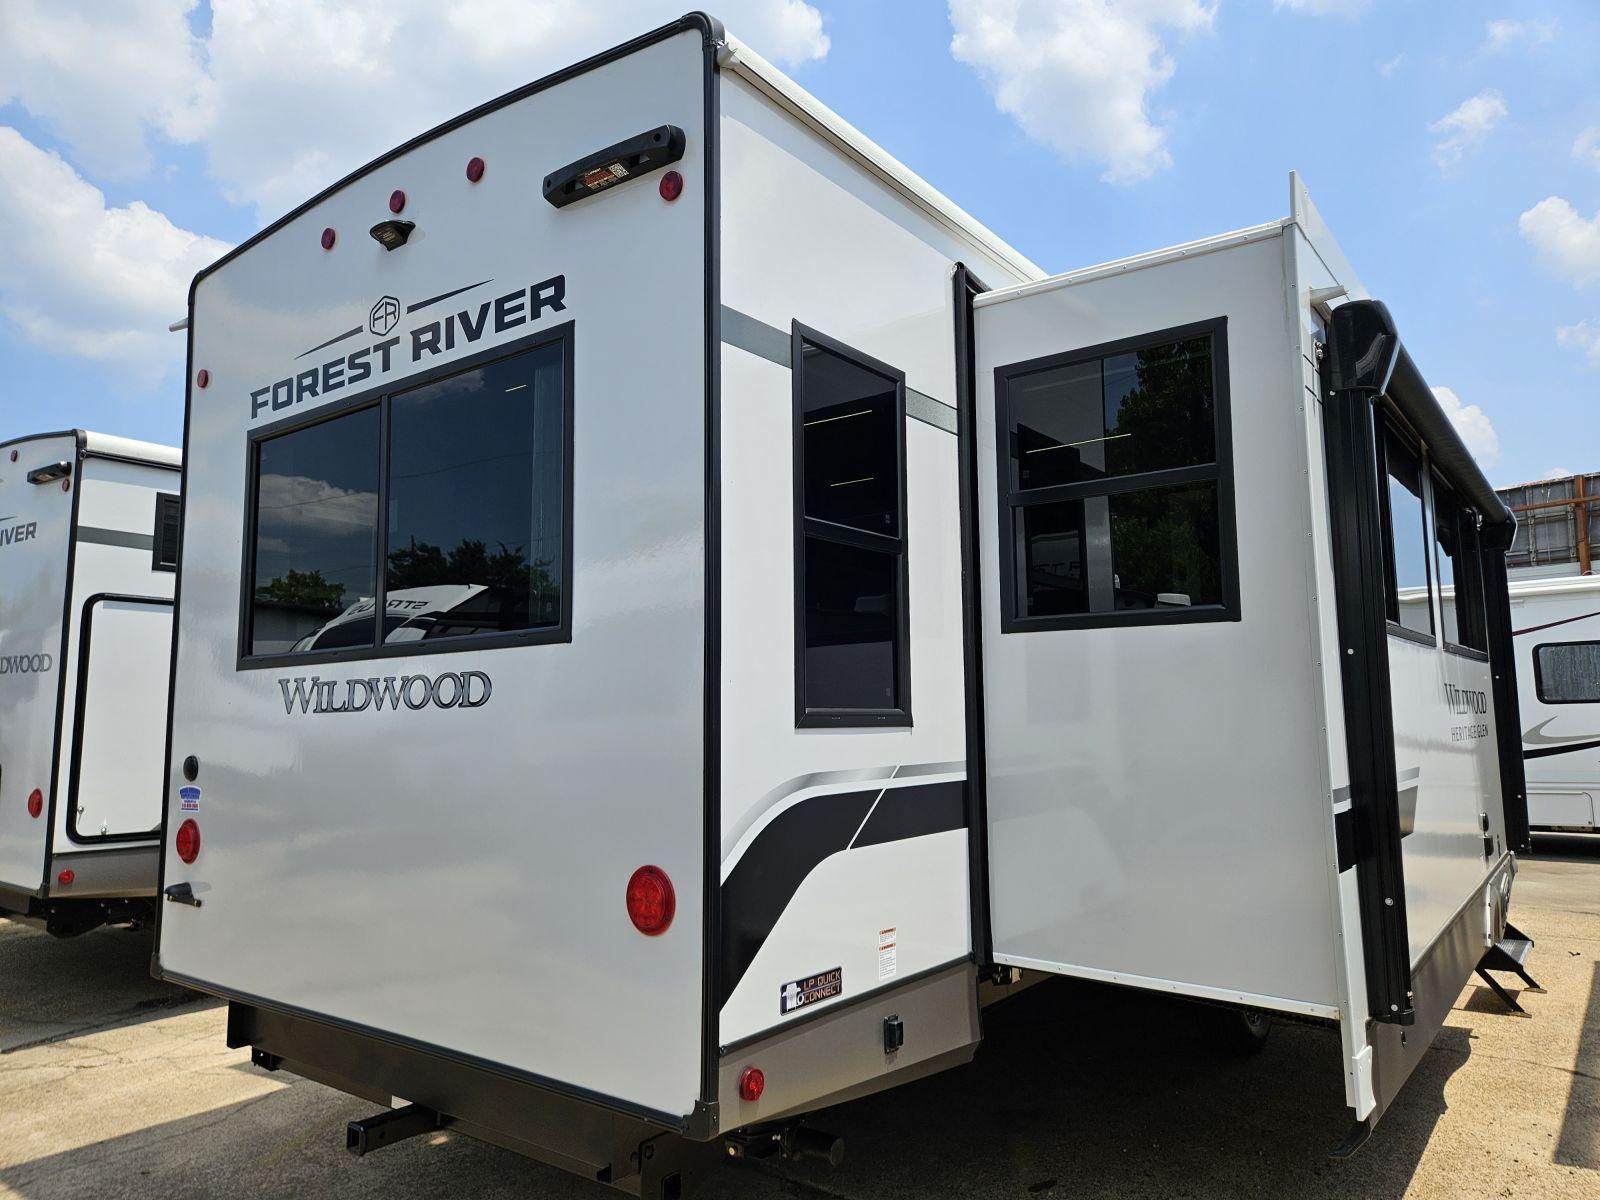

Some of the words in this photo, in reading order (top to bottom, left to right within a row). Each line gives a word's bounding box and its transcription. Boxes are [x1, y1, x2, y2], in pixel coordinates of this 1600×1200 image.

[250, 336, 400, 420] FOREST
[409, 274, 567, 362] RIVER
[278, 670, 492, 714] WILDWOOD
[803, 979, 815, 990] LP
[817, 970, 841, 986] QUICK
[804, 982, 841, 1003] CONNECT
